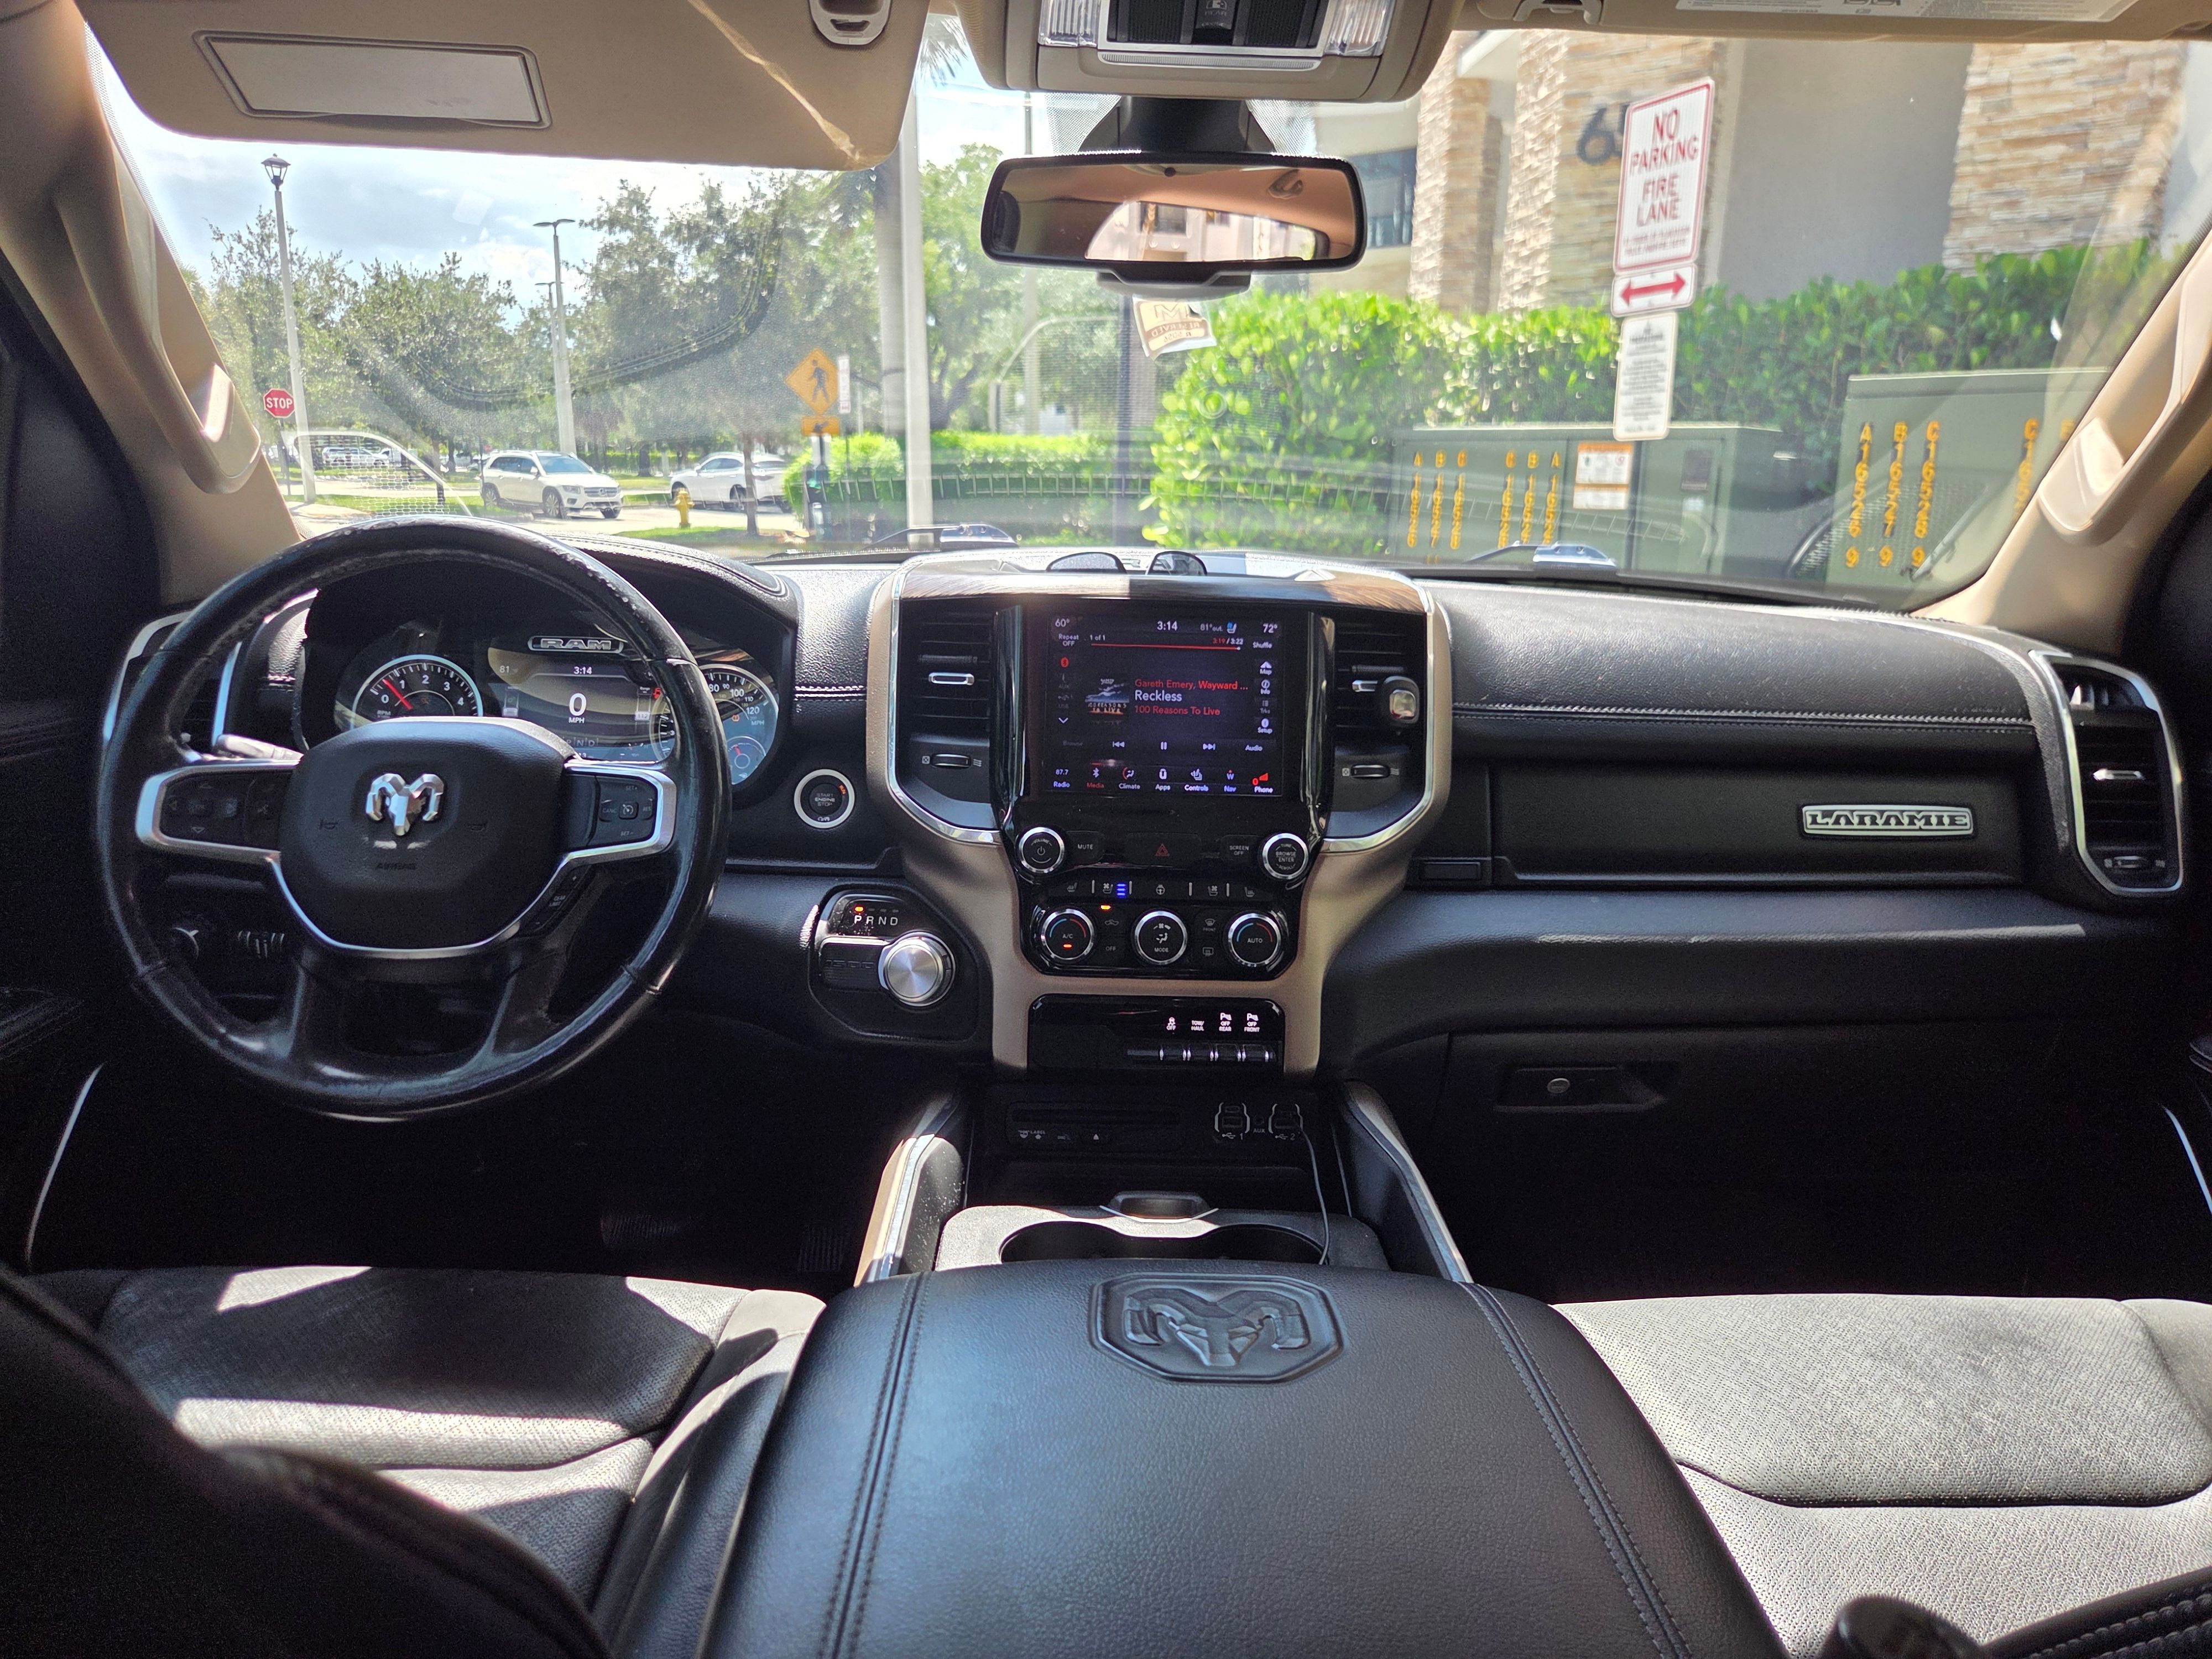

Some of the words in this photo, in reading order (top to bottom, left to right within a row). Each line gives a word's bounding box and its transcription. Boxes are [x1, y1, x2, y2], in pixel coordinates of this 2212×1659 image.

[1652, 109, 1681, 144] NO
[1630, 134, 1699, 176] PARKING
[1642, 173, 1679, 203] FIRE
[1636, 197, 1681, 227] LANE
[266, 397, 293, 409] STOP
[1551, 451, 1561, 469] A
[1055, 618, 1070, 628] 60°
[1157, 620, 1178, 632] 3:14
[1262, 623, 1278, 633] 72°
[540, 638, 611, 650] RAM
[1252, 641, 1273, 649] Shuffle
[573, 666, 593, 675] 3:14
[399, 679, 405, 690] 1
[421, 674, 430, 685] 2
[1134, 679, 1164, 688] Gareth
[1166, 679, 1197, 690] Emery,
[1198, 680, 1238, 691] Wayward
[444, 681, 451, 691] 3
[730, 688, 745, 697] 100
[1134, 689, 1183, 702] Reckless
[380, 694, 389, 704] 0
[457, 696, 465, 706] 4
[568, 692, 587, 717] 0
[746, 706, 760, 715] 120
[1134, 705, 1151, 714] 100
[1152, 705, 1189, 714] Reasons
[1190, 706, 1201, 715] To
[1203, 707, 1220, 716] Live
[1807, 811, 1969, 828] LARAMIE
[854, 915, 863, 925] P
[866, 915, 874, 926] R
[878, 916, 887, 926] N
[890, 916, 899, 926] D
